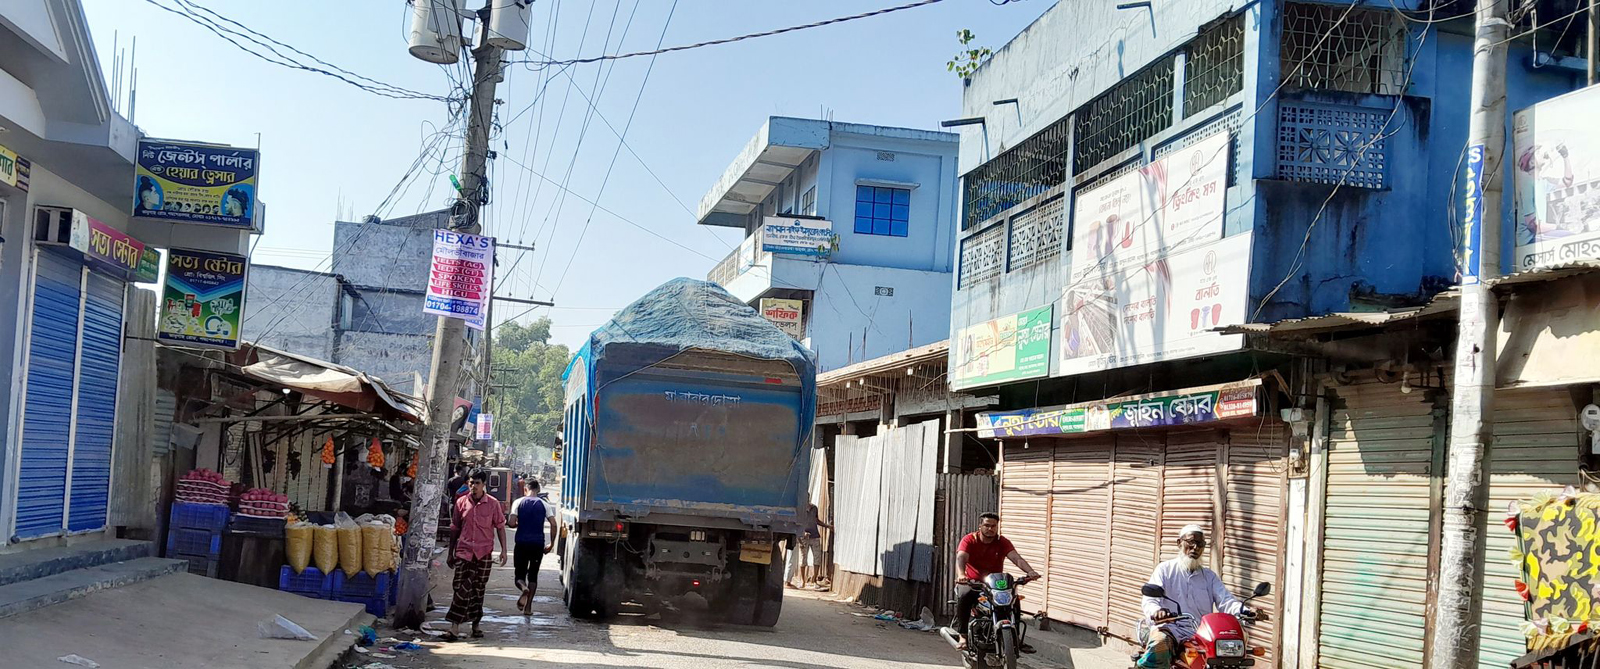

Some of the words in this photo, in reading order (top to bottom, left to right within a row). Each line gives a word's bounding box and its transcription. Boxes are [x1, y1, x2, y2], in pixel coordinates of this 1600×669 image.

[210, 152, 252, 170] পার্লার
[166, 166, 199, 180] হেয়ার
[202, 168, 235, 184] ড্রেসার
[1202, 180, 1217, 196] মগ
[91, 227, 112, 257] সত্য
[435, 230, 489, 248] HEXA'S
[436, 247, 485, 259] মৌলভীবাজার
[1523, 246, 1555, 268] মেসার্স
[170, 254, 200, 270] সত্য
[436, 256, 462, 266] IELTS
[463, 261, 482, 269] (AC)
[436, 264, 460, 273] IELTS
[434, 279, 452, 288] LIFE
[452, 282, 479, 291] SKILLS
[438, 272, 476, 284] SPOKEN
[1195, 282, 1220, 300] বালতি
[765, 308, 798, 319] শফিক
[664, 390, 677, 403] মা
[679, 391, 710, 405] বাবার
